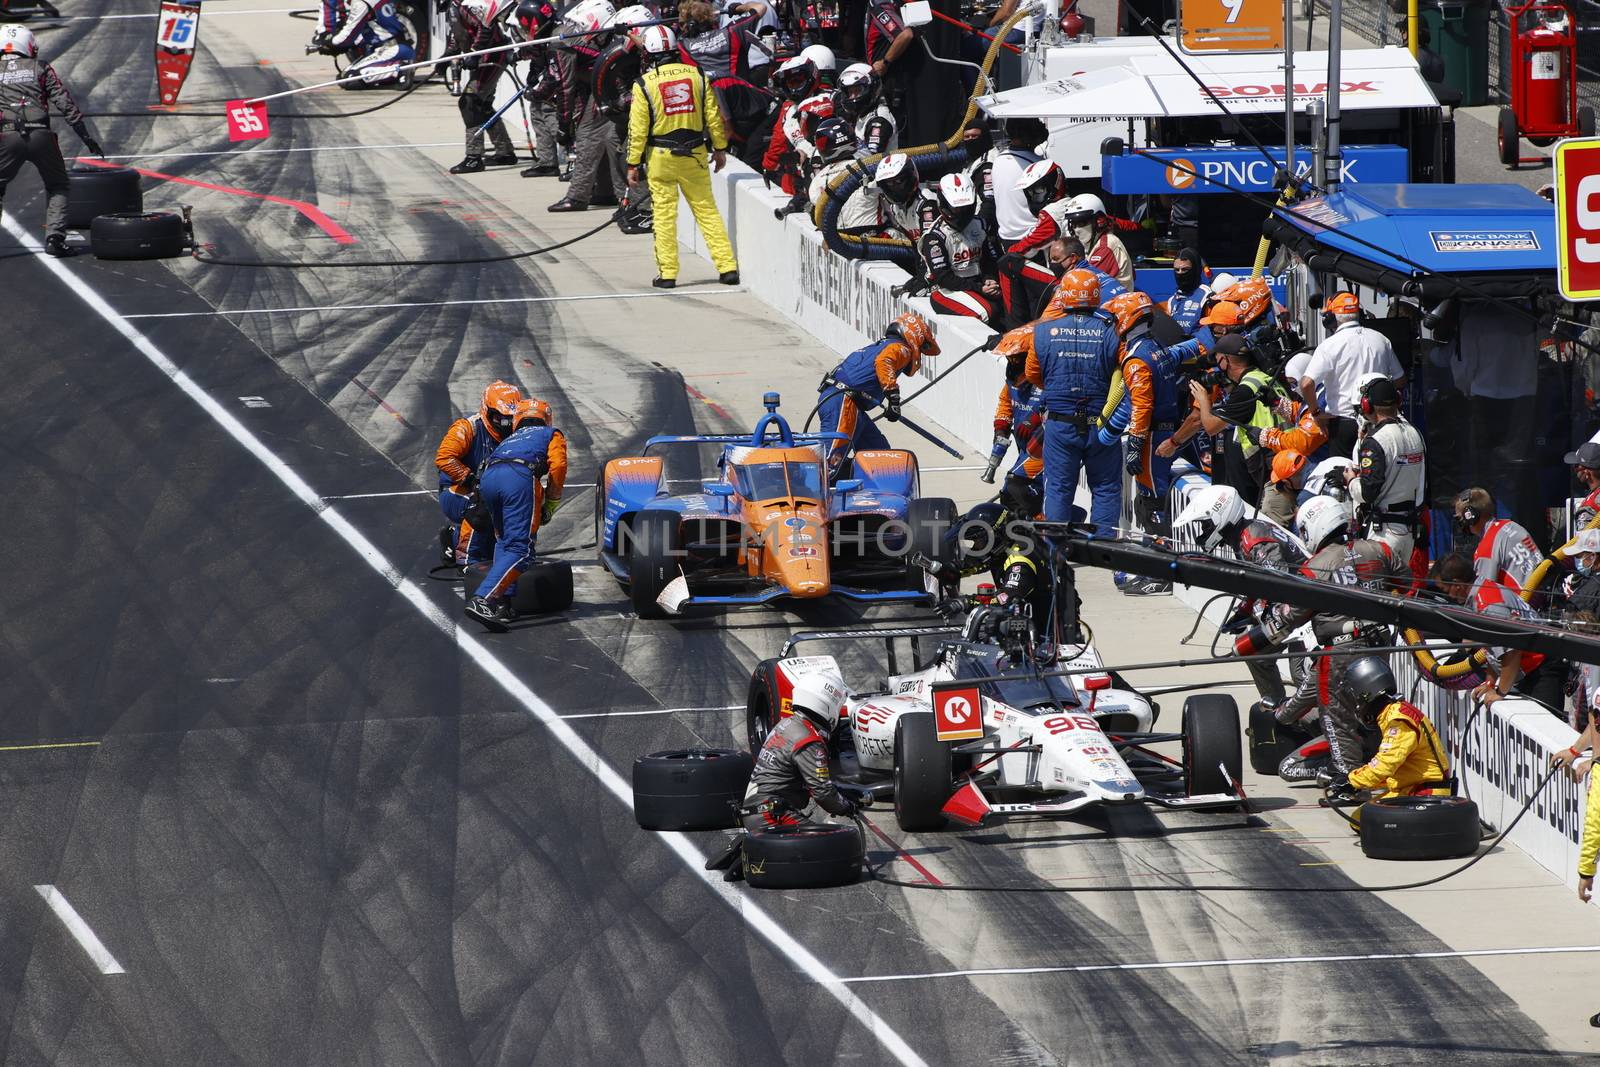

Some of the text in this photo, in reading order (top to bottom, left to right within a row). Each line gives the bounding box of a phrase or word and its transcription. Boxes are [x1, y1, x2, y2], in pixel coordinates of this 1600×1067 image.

[161, 18, 193, 43] 15
[648, 68, 696, 81] OFFICIAL
[1198, 81, 1379, 97] SONAX
[231, 107, 263, 133] 55
[1200, 159, 1268, 186] PNC
[1248, 288, 1266, 304] PNC
[1060, 327, 1079, 336] PNC
[1211, 501, 1223, 513] US
[1305, 508, 1316, 520] US
[1332, 565, 1358, 585] US
[787, 658, 806, 666] US
[824, 682, 835, 694] US
[950, 701, 971, 722] K
[1043, 716, 1101, 736] 98
